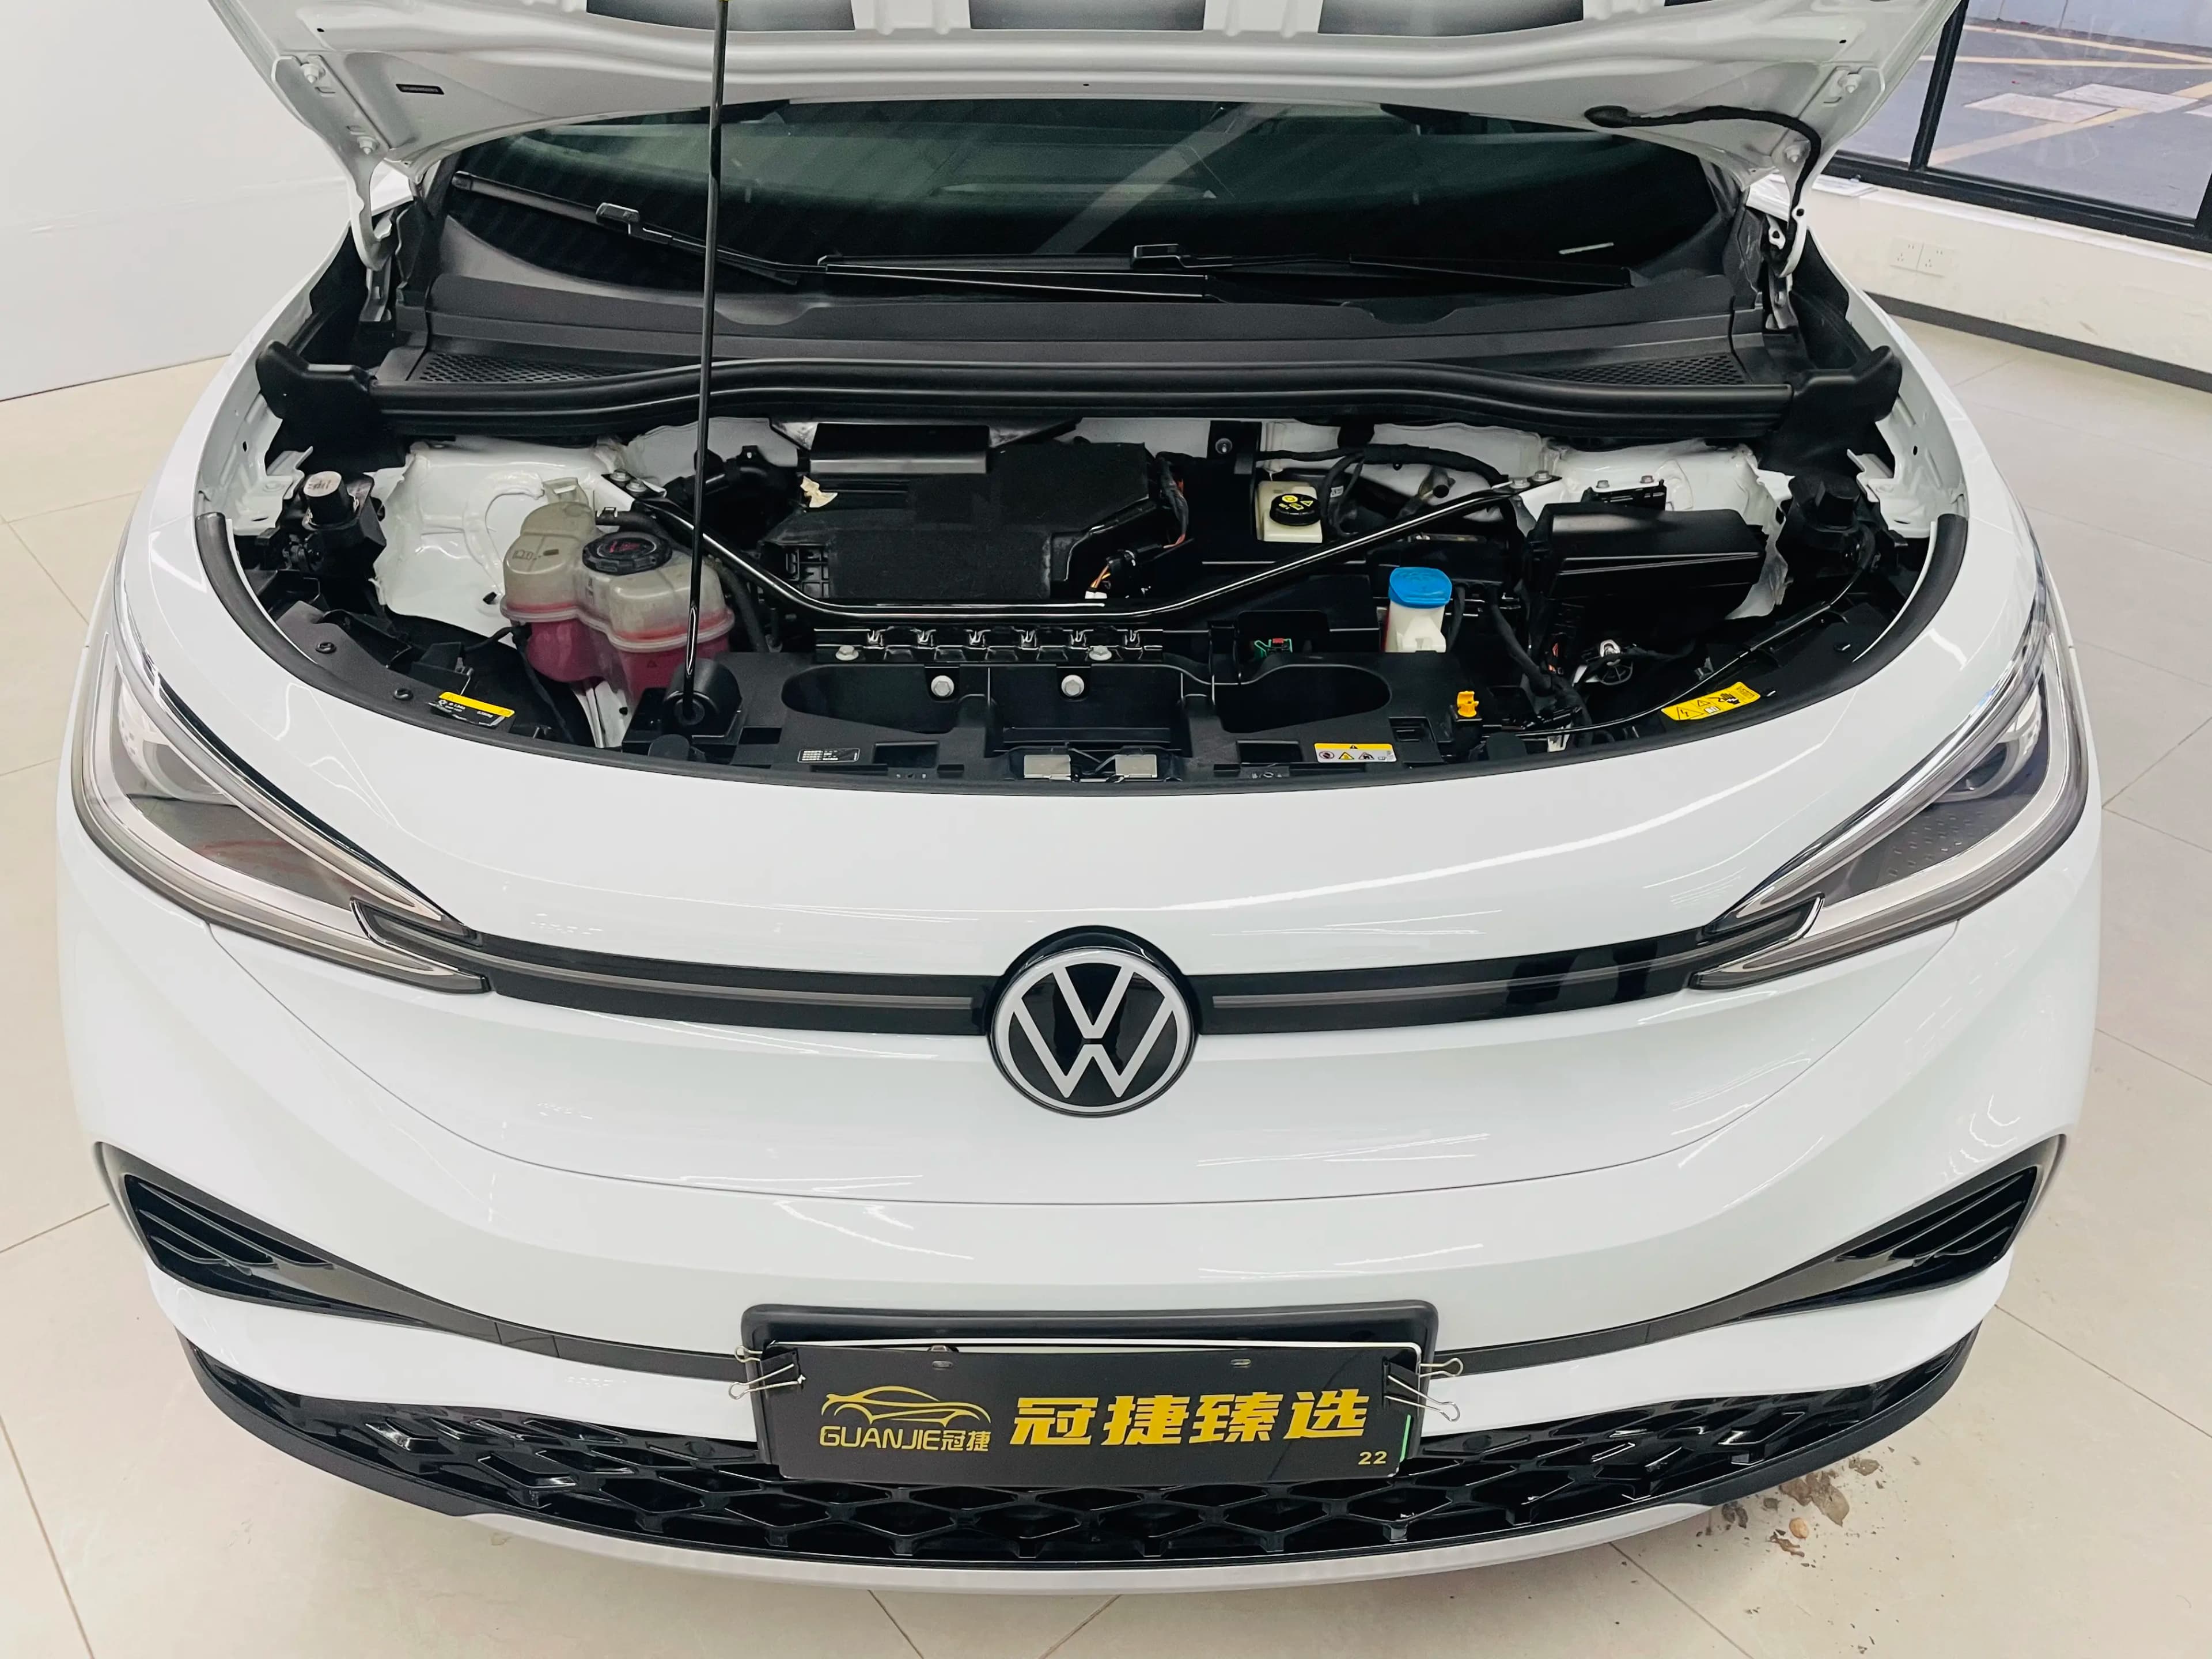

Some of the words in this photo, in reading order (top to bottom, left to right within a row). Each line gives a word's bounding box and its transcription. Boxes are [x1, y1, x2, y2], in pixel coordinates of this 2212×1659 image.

[1005, 961, 1181, 1099] VW
[1011, 1389, 1369, 1445] 冠捷臻选
[1358, 1450, 1387, 1465] 22
